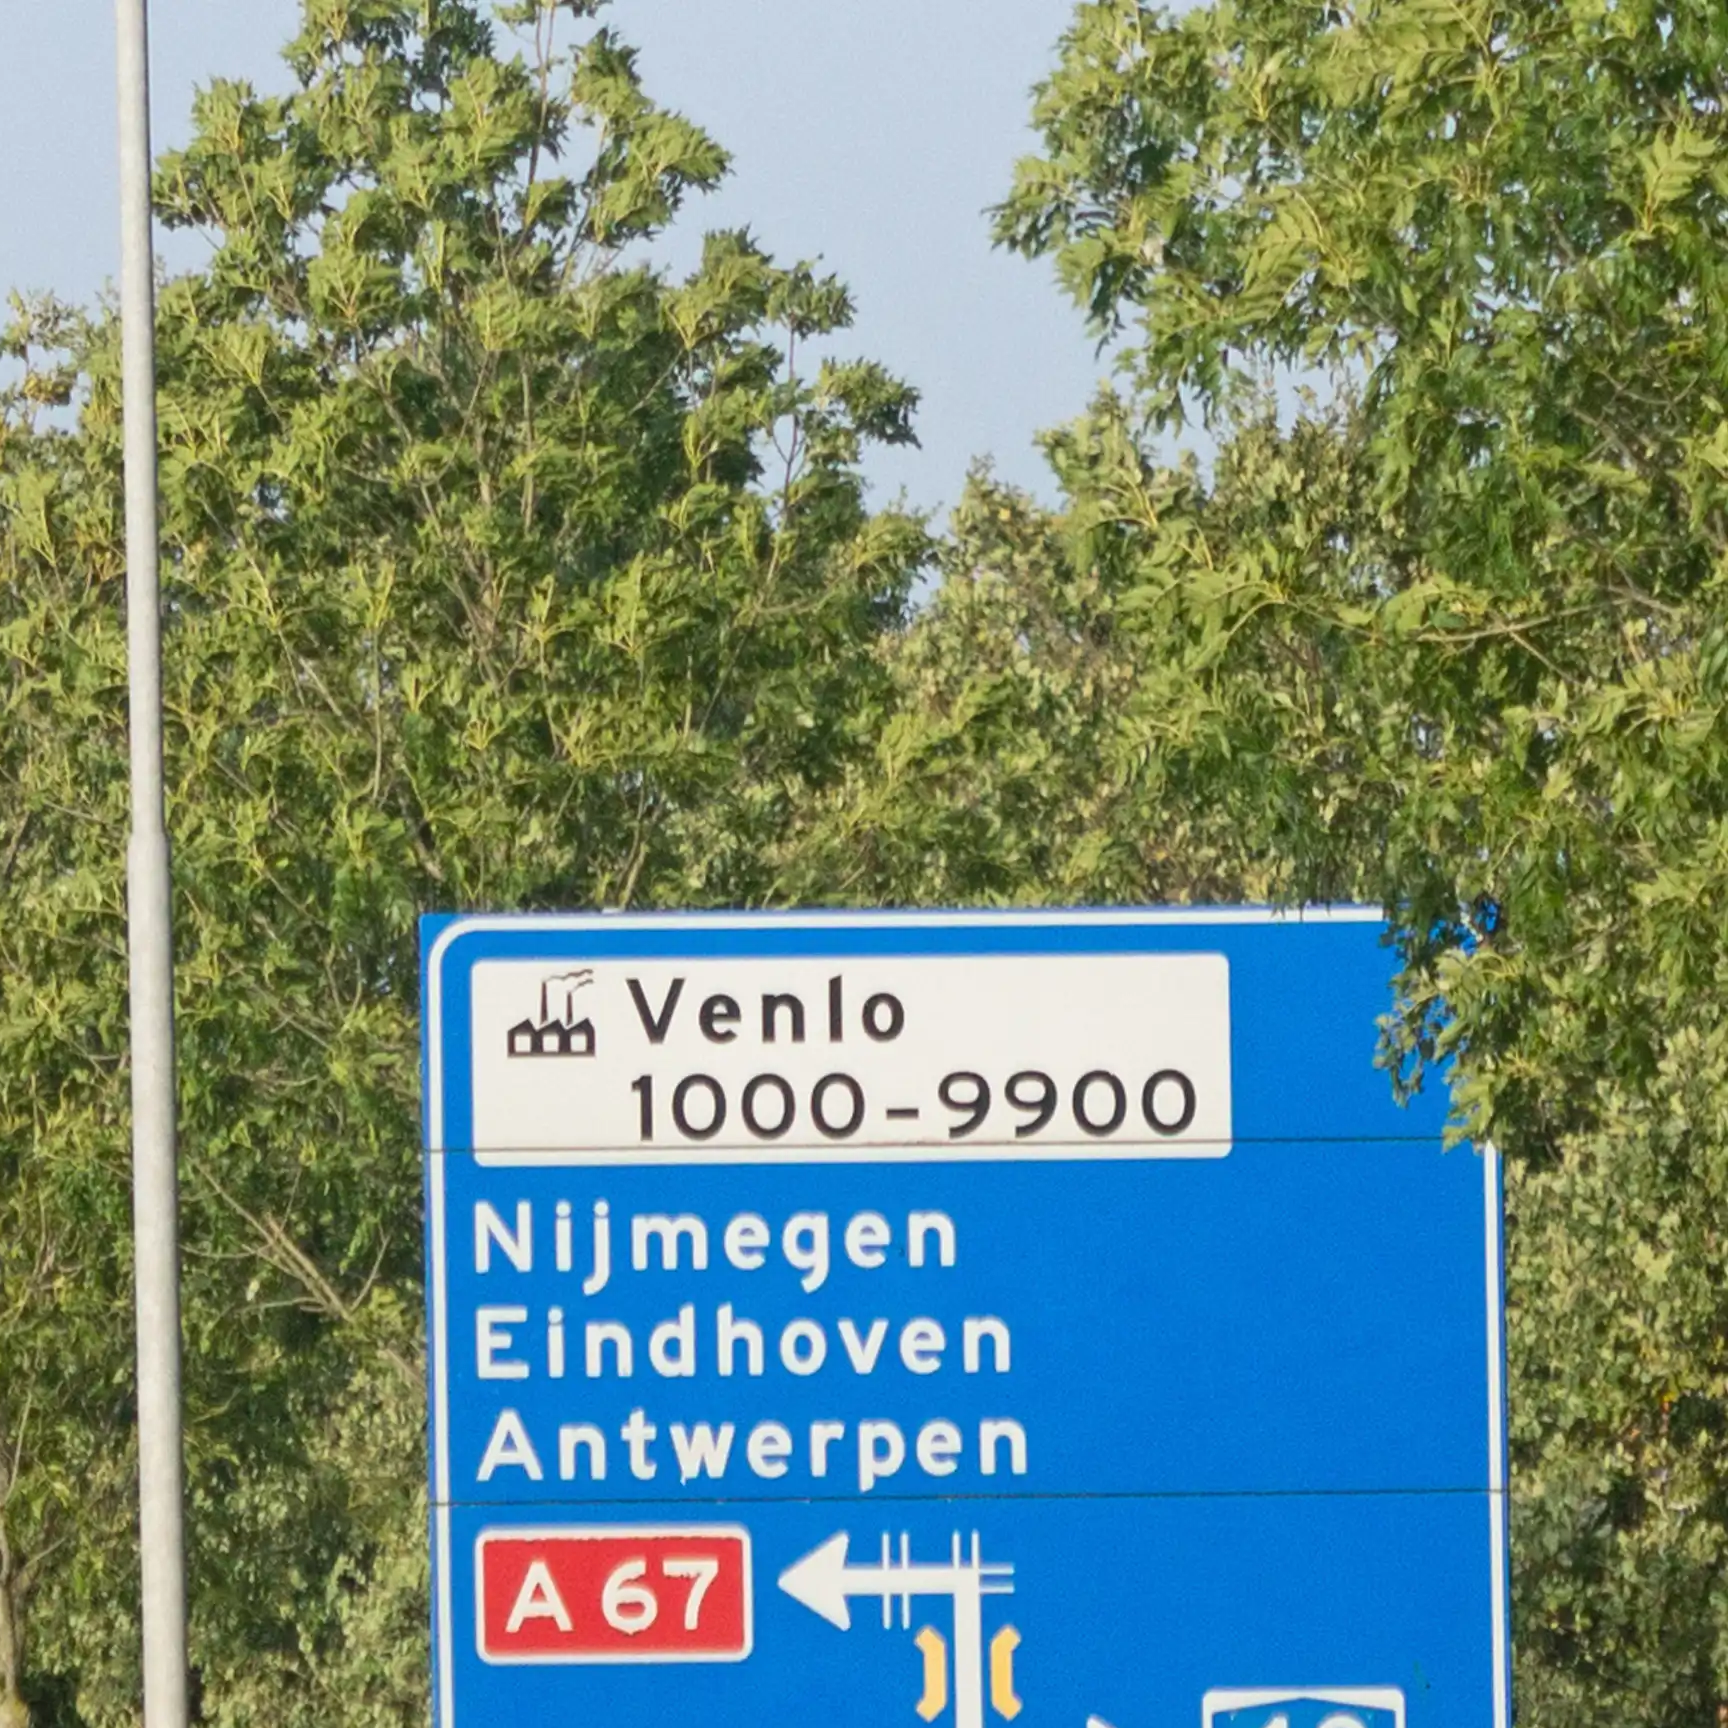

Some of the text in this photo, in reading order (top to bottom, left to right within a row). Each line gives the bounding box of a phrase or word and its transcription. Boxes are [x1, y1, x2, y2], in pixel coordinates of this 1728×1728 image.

[626, 974, 906, 1045] Venlo
[631, 1069, 1197, 1141] 1000-9900
[474, 1200, 957, 1295] Nijmegen
[475, 1303, 1012, 1379] Eindhoven
[476, 1408, 1028, 1492] Antwerpen
[505, 1557, 720, 1635] A 67
